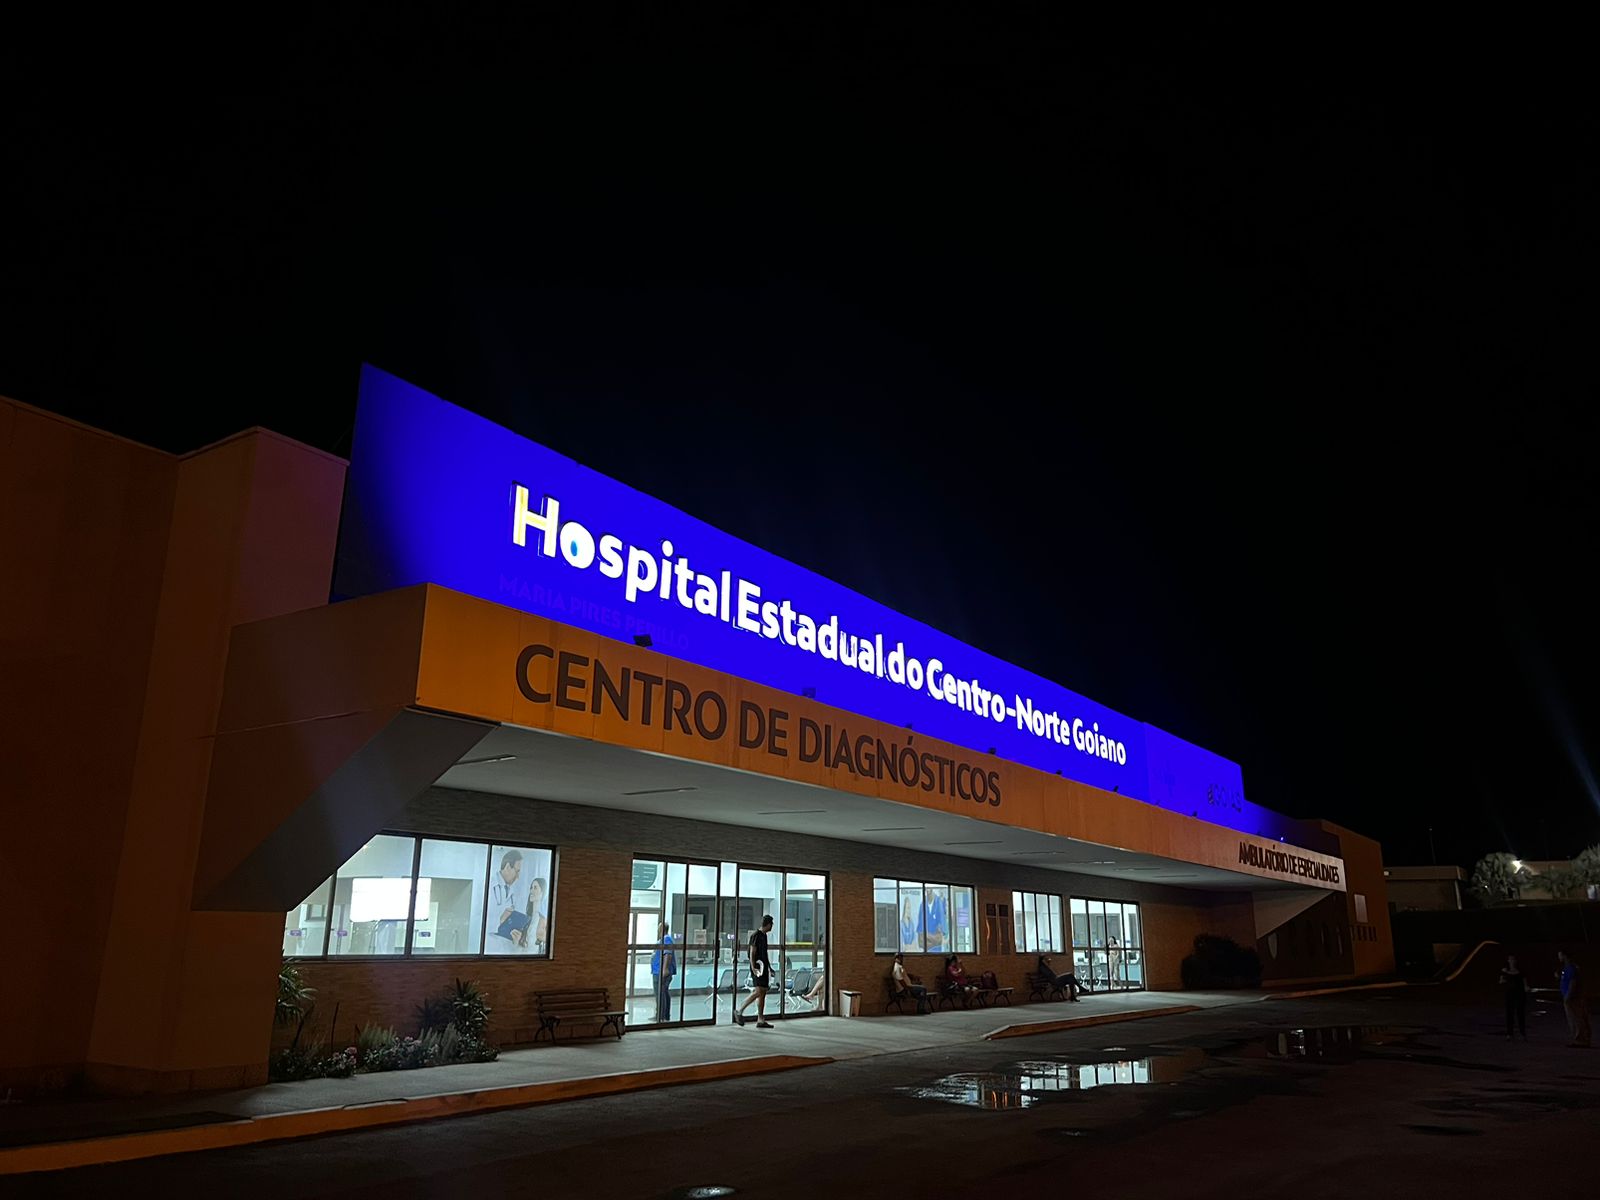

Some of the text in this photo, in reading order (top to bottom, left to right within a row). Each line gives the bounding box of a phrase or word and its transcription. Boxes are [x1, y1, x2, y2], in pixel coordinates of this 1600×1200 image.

[511, 483, 1127, 766] Hospital Estadual do Centro-Norte Goiano
[515, 643, 1001, 807] CENTRO DE DIAGNÓSTICOS
